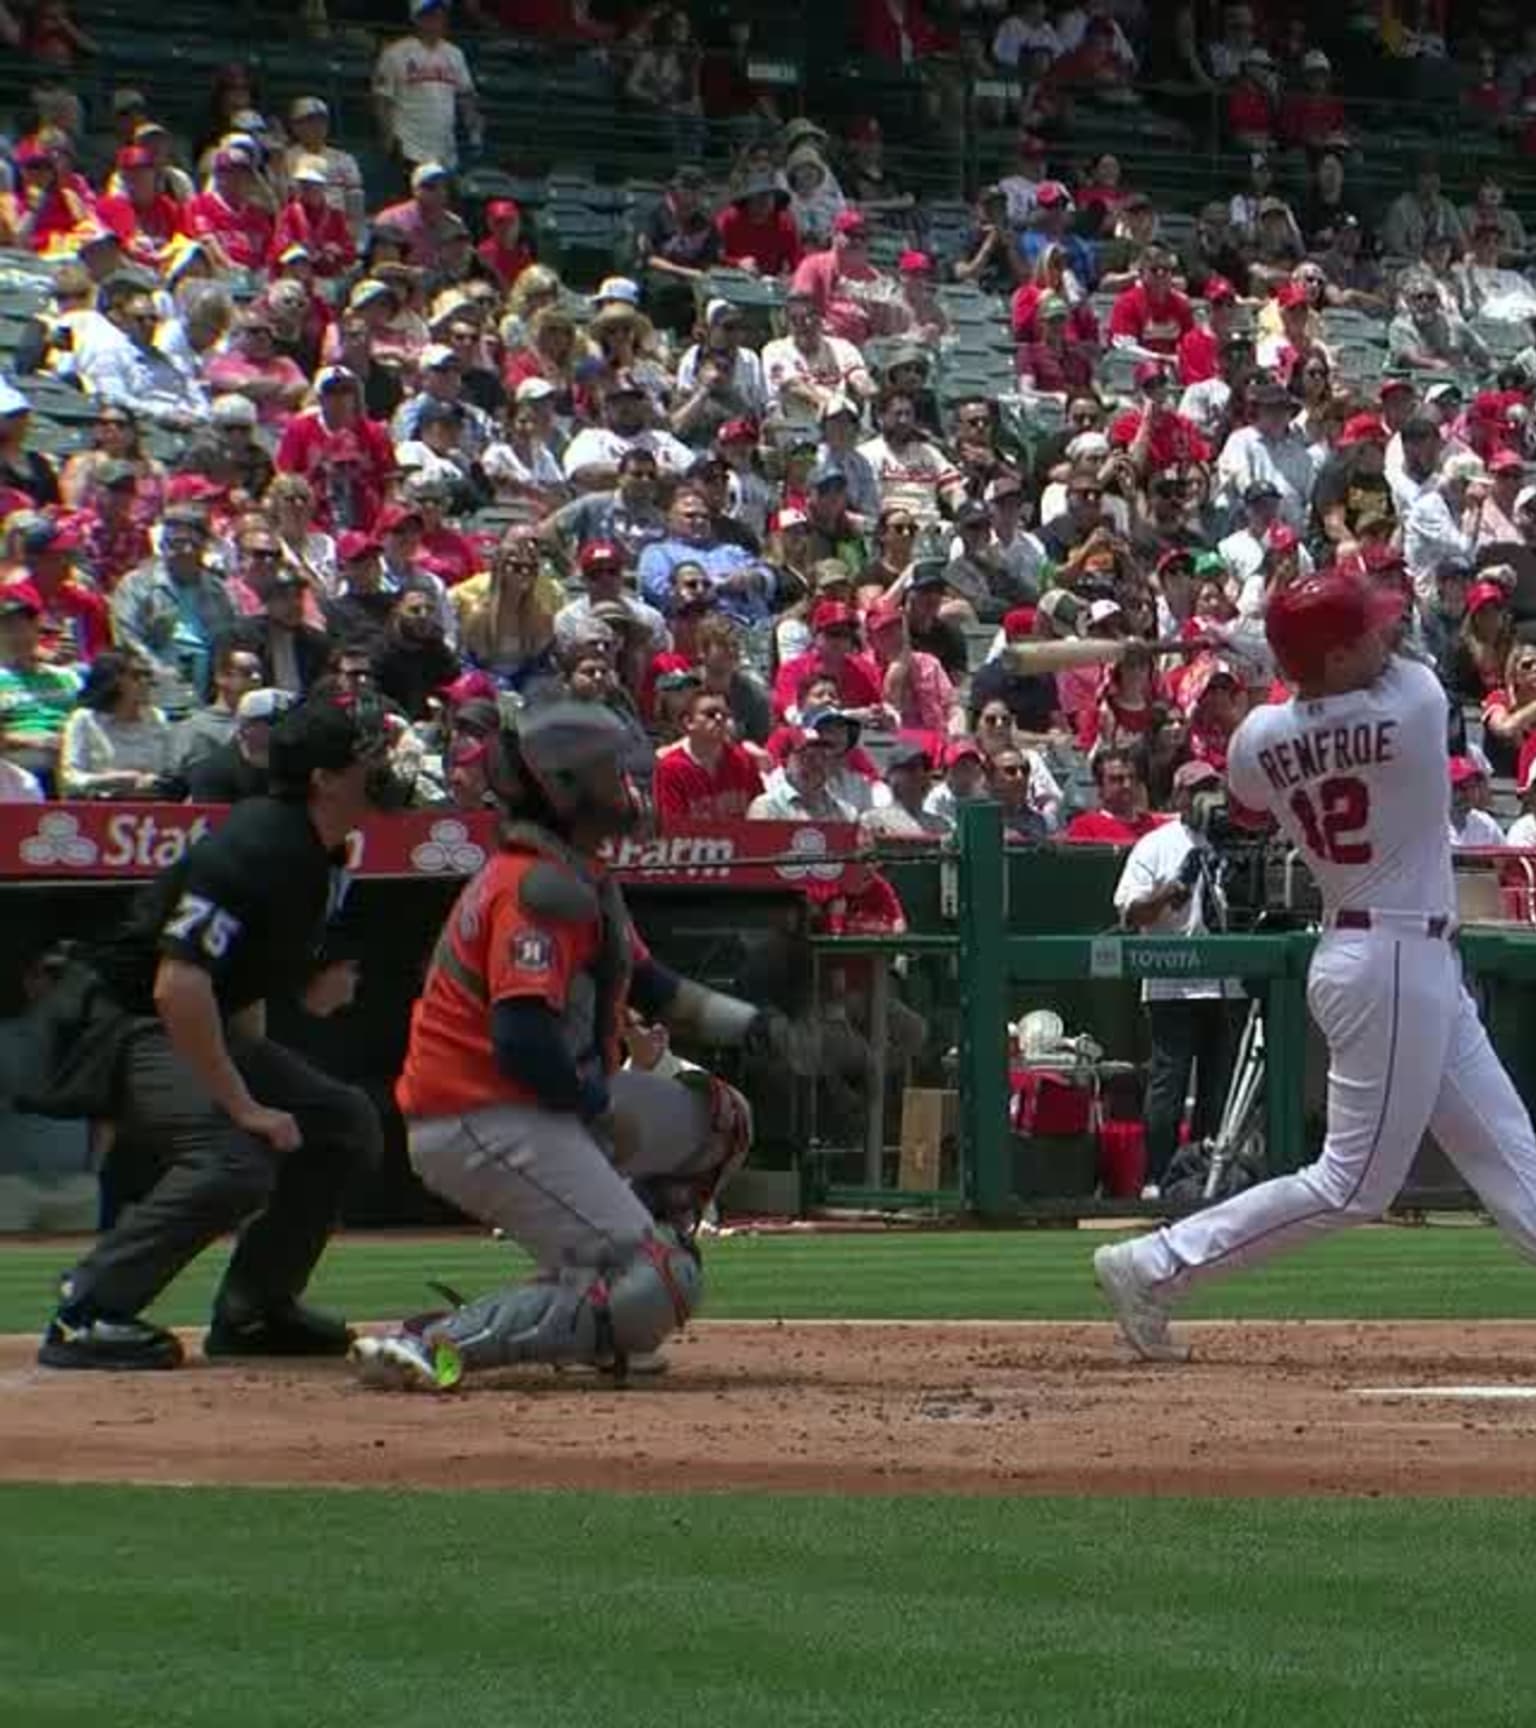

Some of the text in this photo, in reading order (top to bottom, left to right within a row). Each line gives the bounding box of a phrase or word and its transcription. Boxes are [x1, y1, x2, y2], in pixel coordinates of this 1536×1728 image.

[1258, 720, 1398, 790] RENFROE
[103, 813, 210, 868] Stat
[1290, 776, 1374, 865] 12
[163, 891, 242, 957] 75
[1131, 949, 1202, 969] TOYOTA
